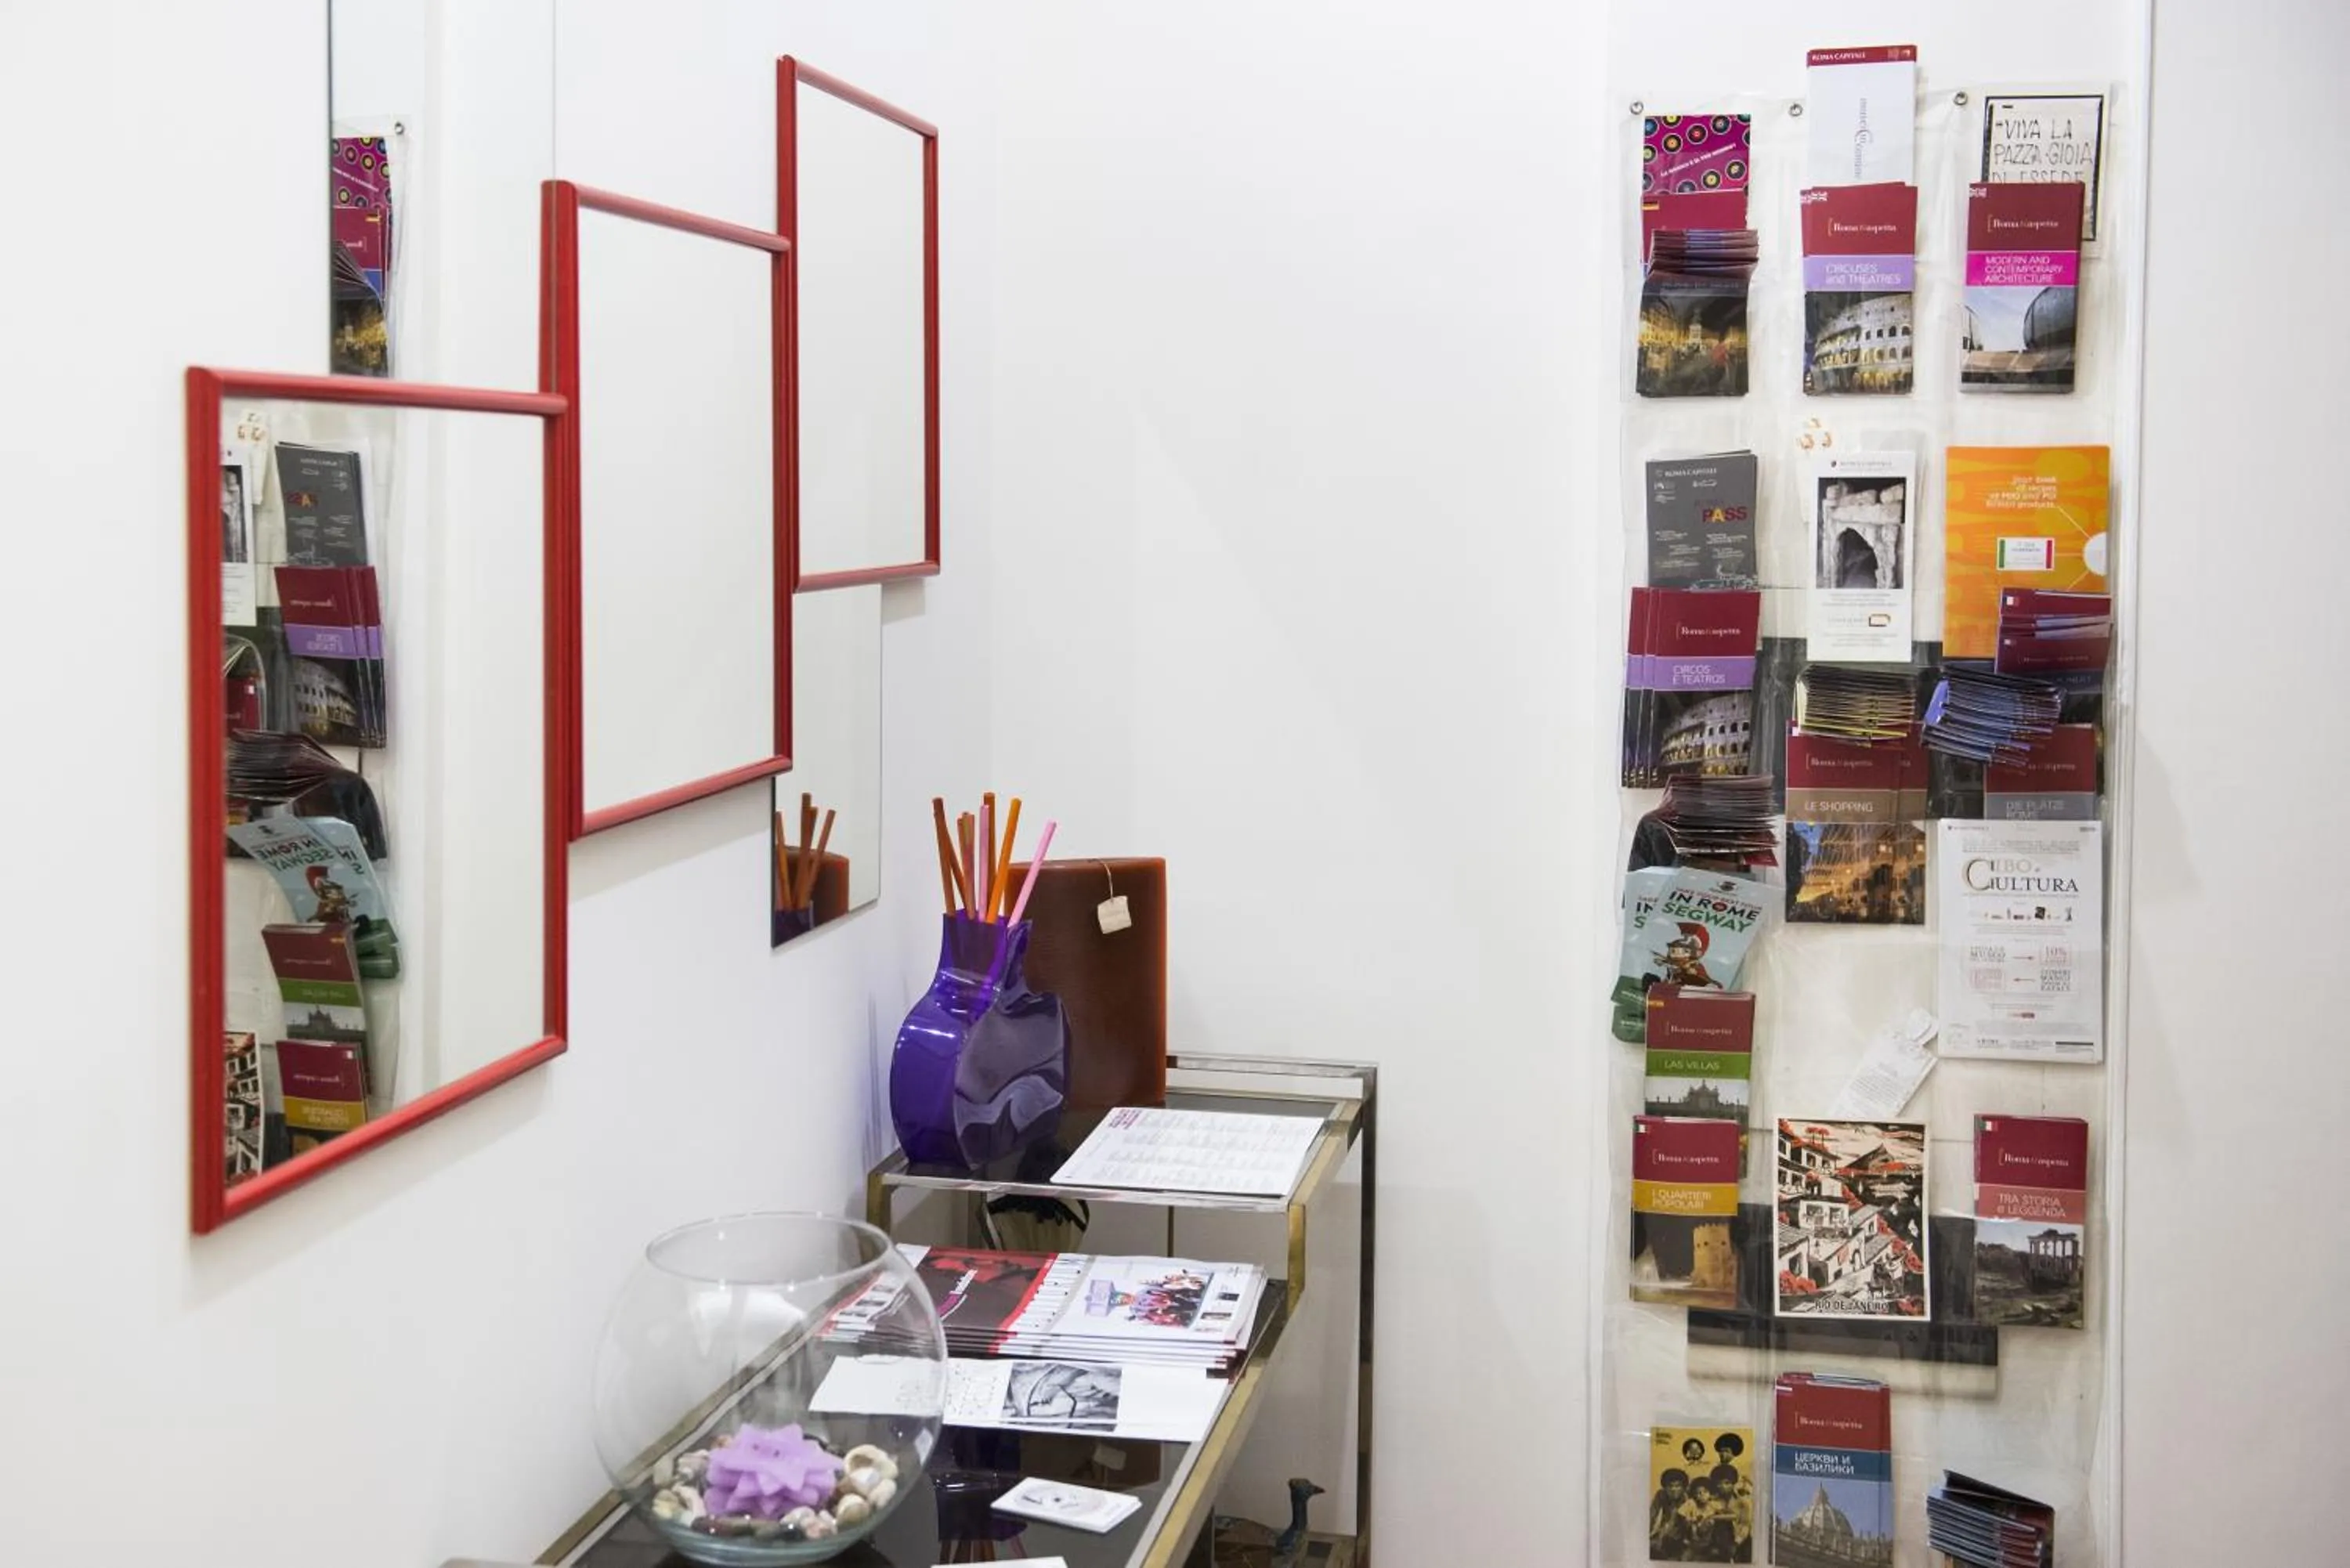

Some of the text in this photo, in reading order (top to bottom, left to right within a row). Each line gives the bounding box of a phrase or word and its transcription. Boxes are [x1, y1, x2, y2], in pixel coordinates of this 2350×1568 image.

[2051, 118, 2073, 139] LA
[1994, 142, 2093, 165] PAZZA GIOIA
[1848, 274, 1901, 284] THEATRES
[1702, 506, 1748, 523] PASS
[1673, 665, 1711, 674] CIRCOS
[1682, 675, 1726, 685] TEATROS
[1805, 801, 1874, 812] LE SHOPPING
[1669, 891, 1760, 921] IN ROME
[1661, 902, 1752, 934] SEGWAY
[1665, 1060, 1720, 1070] LAS VILLAS
[1999, 1193, 2061, 1206] TRA STORIA
[2008, 1205, 2066, 1217] LEGGENDA
[1815, 1299, 1831, 1310] RIO
[1834, 1299, 1846, 1310] DE
[1795, 1451, 1851, 1465] ЦЕРКВИ И
[1795, 1462, 1855, 1474] БАЗИЛИКИ
